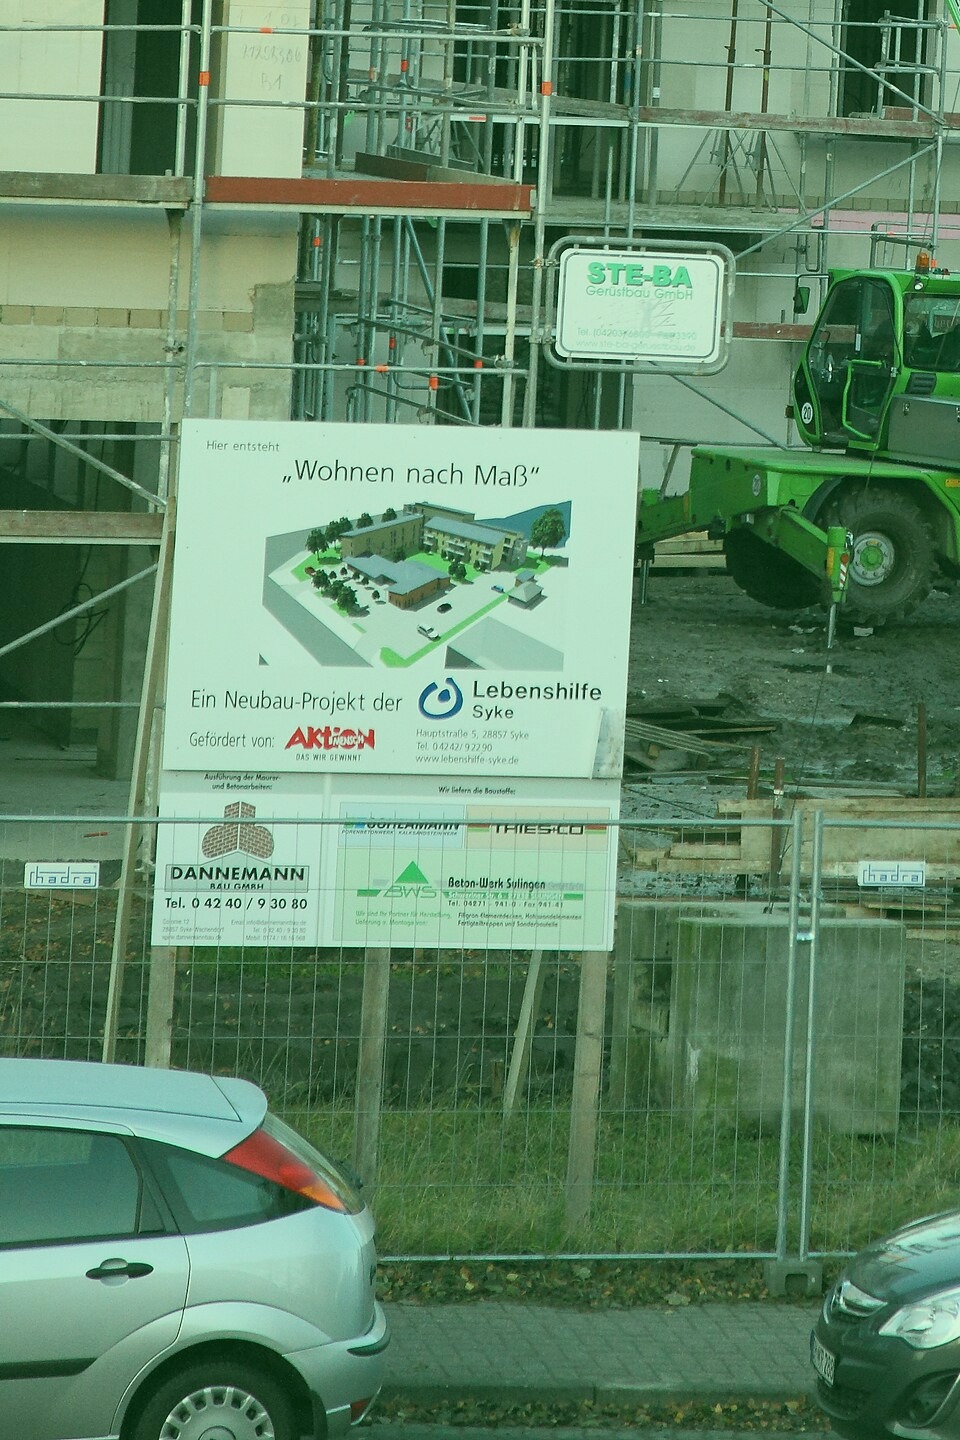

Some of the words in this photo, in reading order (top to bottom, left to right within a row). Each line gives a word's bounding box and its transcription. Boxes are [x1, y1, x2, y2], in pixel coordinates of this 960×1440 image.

[587, 261, 693, 288] STE-BA
[585, 285, 650, 299] Gerüstbau
[654, 288, 693, 301] GmbH
[803, 406, 811, 420] 20
[206, 440, 228, 451] Hier
[232, 441, 280, 452] entsteht
[282, 459, 394, 483] „Wohnen
[407, 462, 463, 485] nach
[475, 464, 540, 487] Maß“
[472, 679, 602, 701] Lebenshilfe
[191, 688, 216, 709] Ein
[224, 690, 365, 716] Neubau-Projekt
[373, 691, 402, 711] der
[472, 704, 514, 721] Syke
[189, 730, 246, 748] Gefördert
[251, 735, 275, 748] von:
[416, 728, 468, 740] Hauptstraße
[482, 730, 507, 739] 28857
[510, 730, 529, 741] Syke
[296, 753, 310, 761] DAS
[312, 753, 327, 762] WIR
[329, 754, 362, 762] GEWINNT
[415, 754, 519, 766] www.lebenshilfe-syke.de
[204, 773, 242, 783] Ausführung
[243, 773, 254, 781] der
[226, 783, 273, 791] Betonarbeiten:
[451, 786, 471, 794] liefern
[484, 787, 516, 795] Baustoffe:
[35, 865, 91, 884] hadra
[170, 866, 305, 881] DANNEMANN
[868, 863, 919, 882] hadra
[210, 883, 231, 891] BAU
[233, 883, 264, 891] GMBH
[448, 876, 504, 889] Beton-Werk
[506, 878, 546, 892] Sulingen
[383, 885, 437, 898] BWS
[165, 897, 186, 909] Tel.
